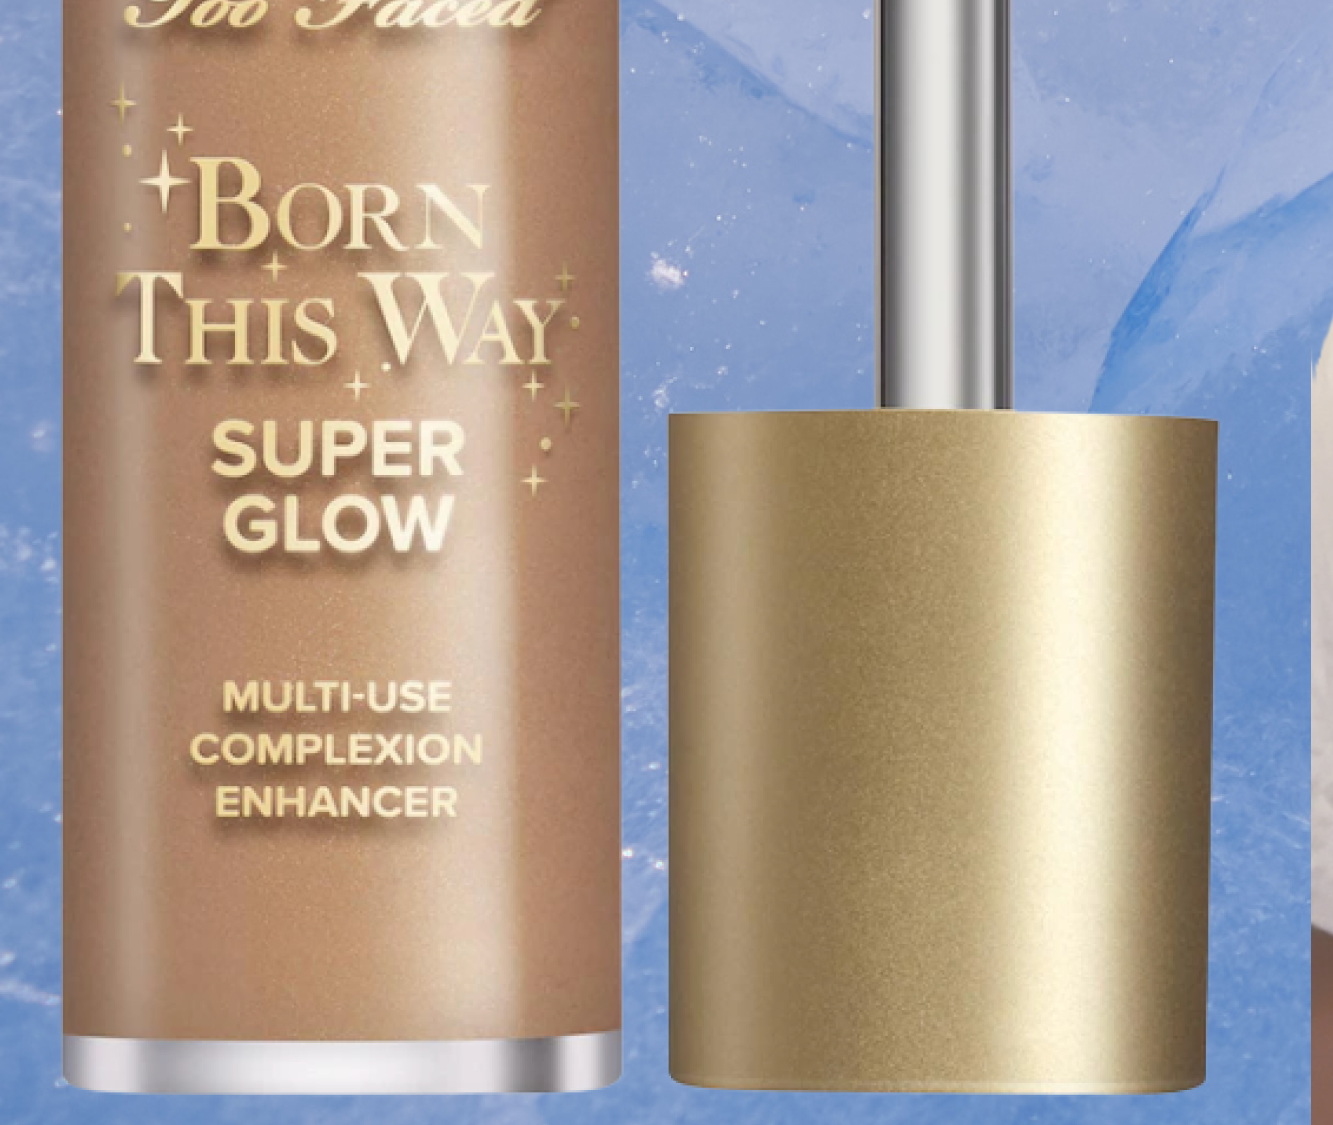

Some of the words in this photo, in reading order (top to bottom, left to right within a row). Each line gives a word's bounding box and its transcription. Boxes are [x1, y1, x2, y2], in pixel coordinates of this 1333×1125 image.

[210, 418, 466, 478] SUPER
[222, 493, 455, 554] GLOW
[221, 679, 453, 714] MULTI-USE
[189, 732, 483, 766] COMPLEXION
[214, 785, 459, 819] ENHANCER
